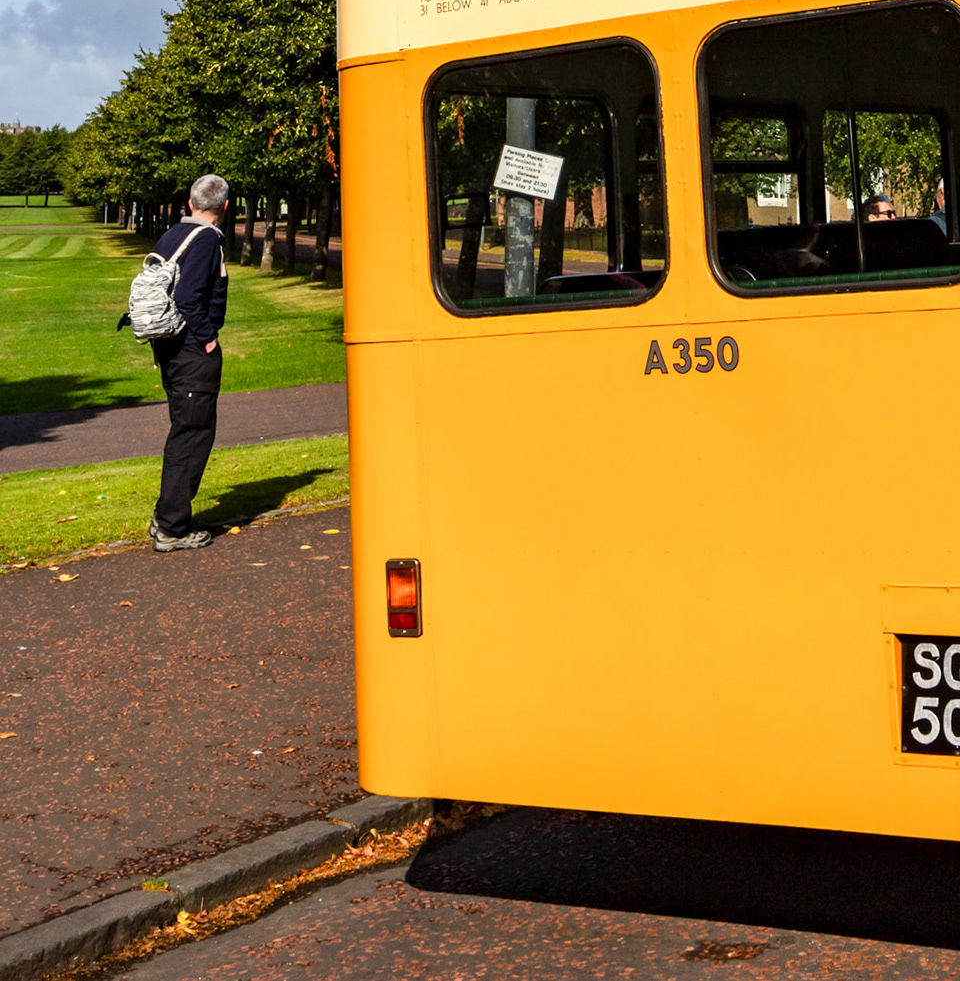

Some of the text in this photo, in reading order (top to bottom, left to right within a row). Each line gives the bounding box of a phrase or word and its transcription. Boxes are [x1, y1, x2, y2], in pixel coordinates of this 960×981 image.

[420, 4, 428, 16] 31
[506, 148, 525, 157] Parking
[644, 335, 739, 375] A350
